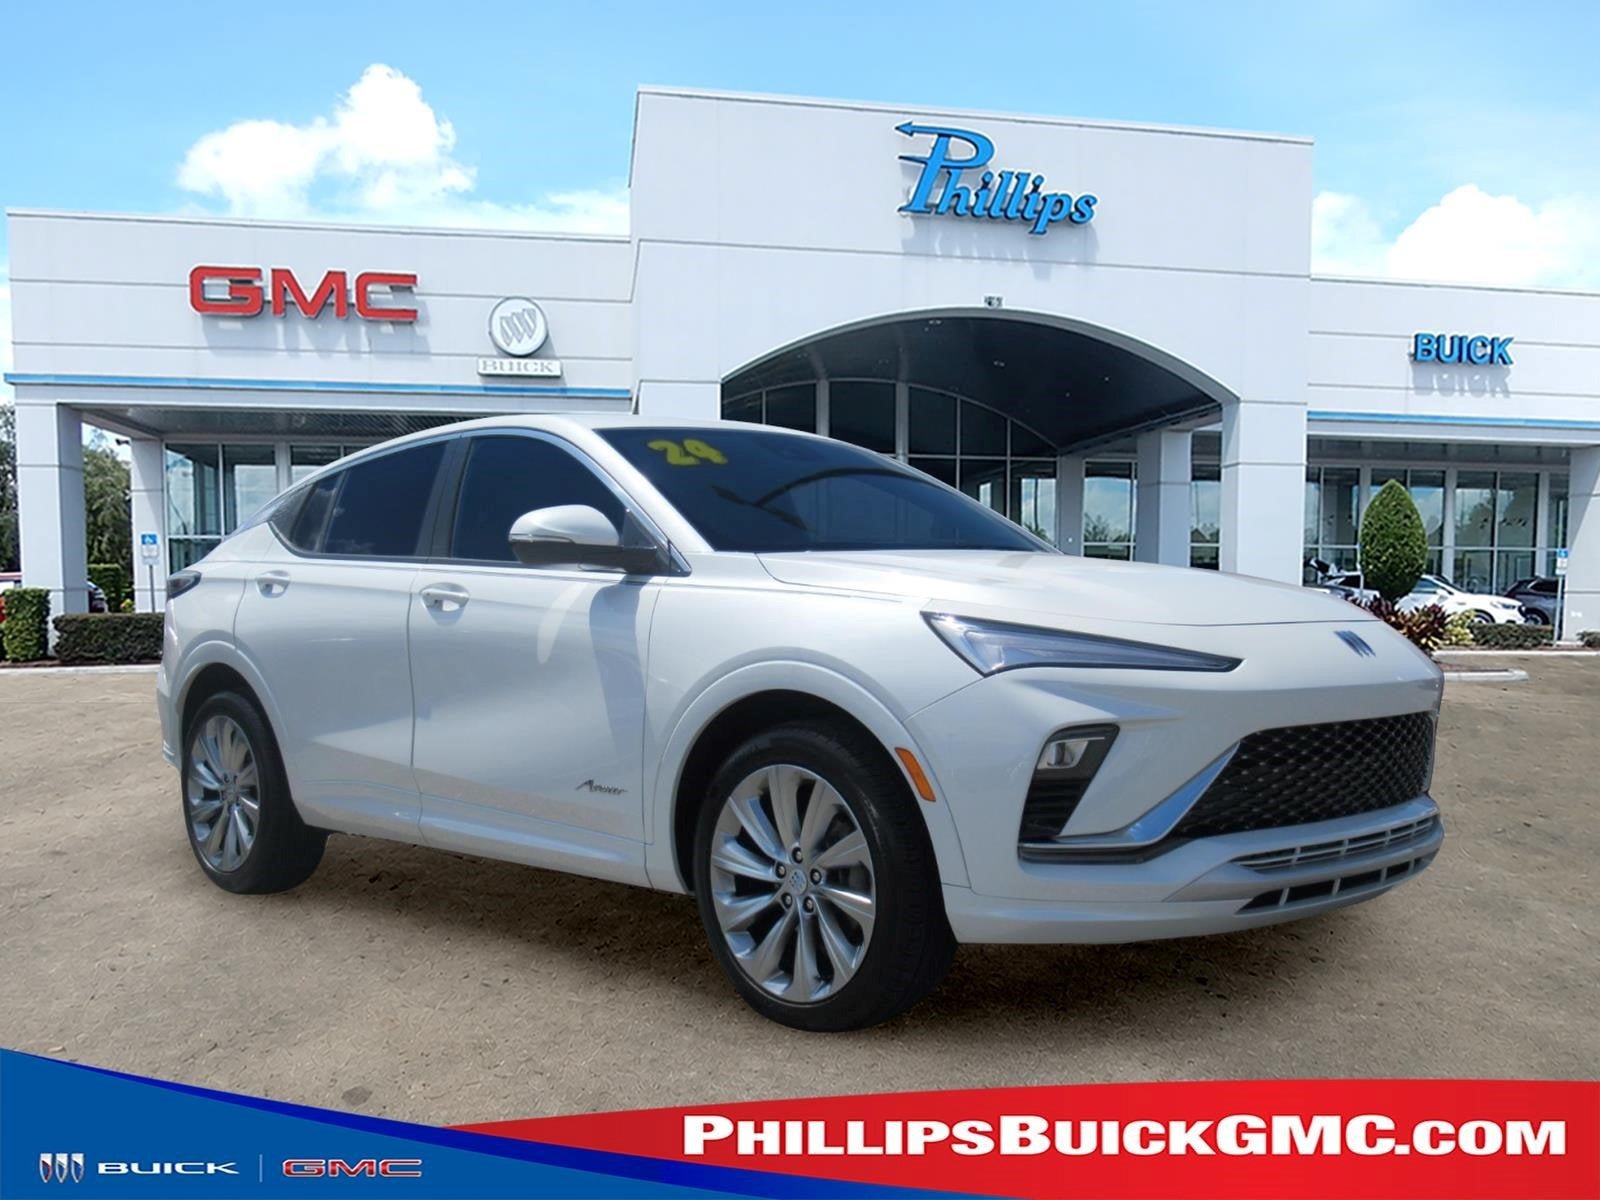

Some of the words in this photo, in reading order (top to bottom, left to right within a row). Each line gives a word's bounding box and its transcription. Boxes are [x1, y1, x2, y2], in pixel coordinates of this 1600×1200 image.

[895, 121, 1098, 235] Phillips
[189, 265, 418, 322] GMC
[481, 359, 554, 375] BUICK
[1414, 332, 1514, 365] BUICK
